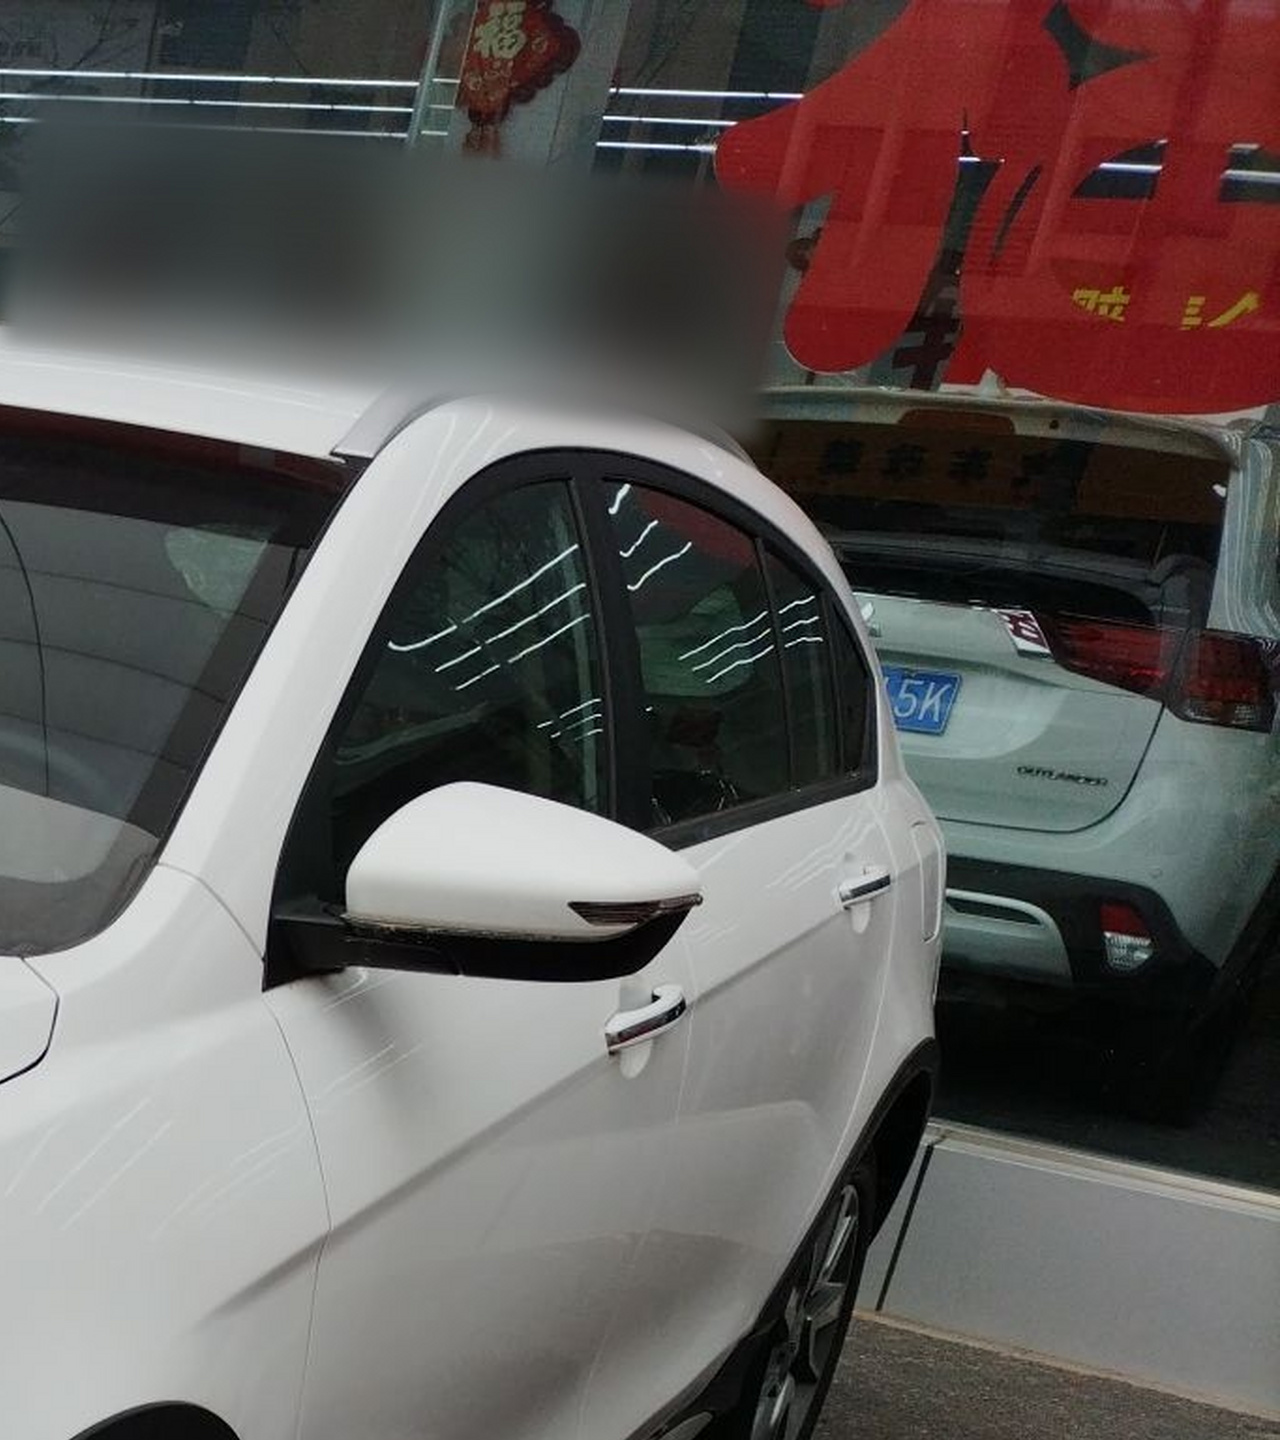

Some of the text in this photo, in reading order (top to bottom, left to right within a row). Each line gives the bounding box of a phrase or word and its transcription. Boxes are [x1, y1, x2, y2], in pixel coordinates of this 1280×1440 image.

[473, 0, 527, 59] 福
[881, 676, 952, 723] 5K
[1016, 765, 1109, 786] OUTLANDER
